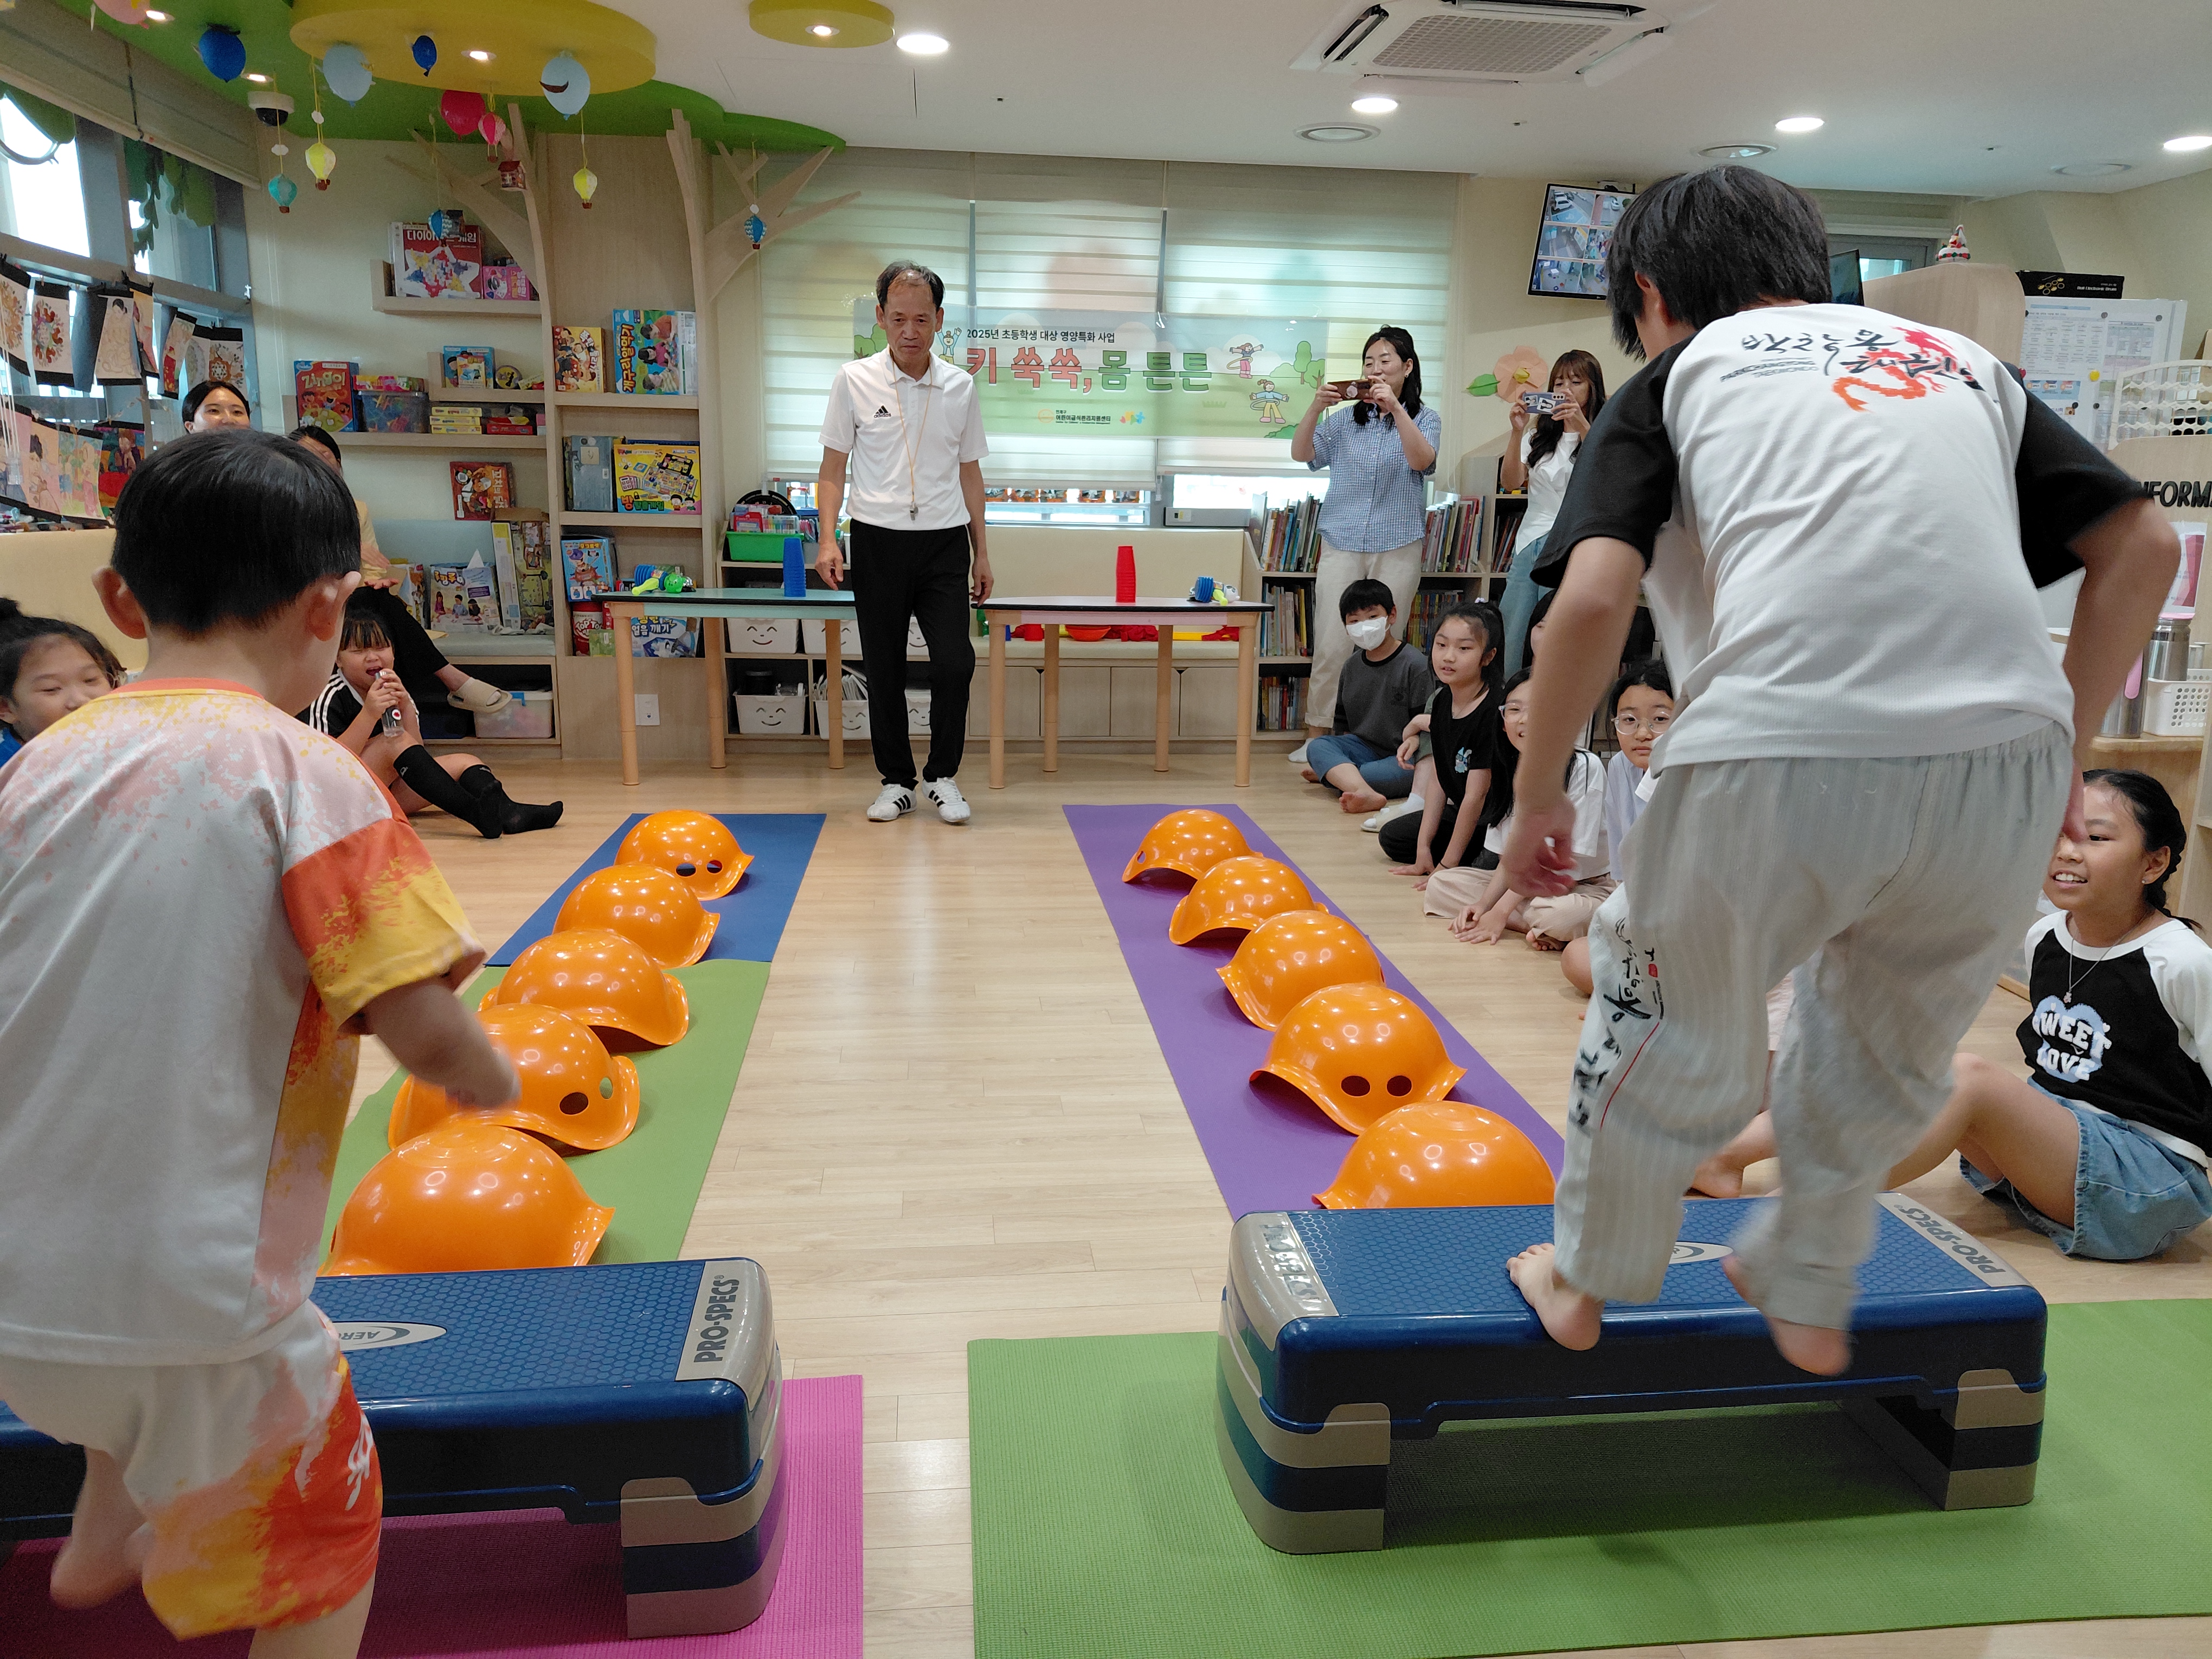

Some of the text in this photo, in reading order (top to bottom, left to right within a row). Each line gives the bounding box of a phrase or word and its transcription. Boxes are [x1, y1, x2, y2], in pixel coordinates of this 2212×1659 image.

[967, 329, 1115, 343] 2025년 초등학생 대상 영양특화 사업
[621, 324, 635, 393] 개구리알먹기
[301, 371, 346, 389] Zingo!
[967, 346, 1212, 394] 키 쑥쑥, 몸 튼튼
[2137, 480, 2212, 507] FORM
[632, 623, 670, 636] 얼음 깨기
[2036, 1047, 2095, 1081] LOVE
[338, 1330, 381, 1340] AER
